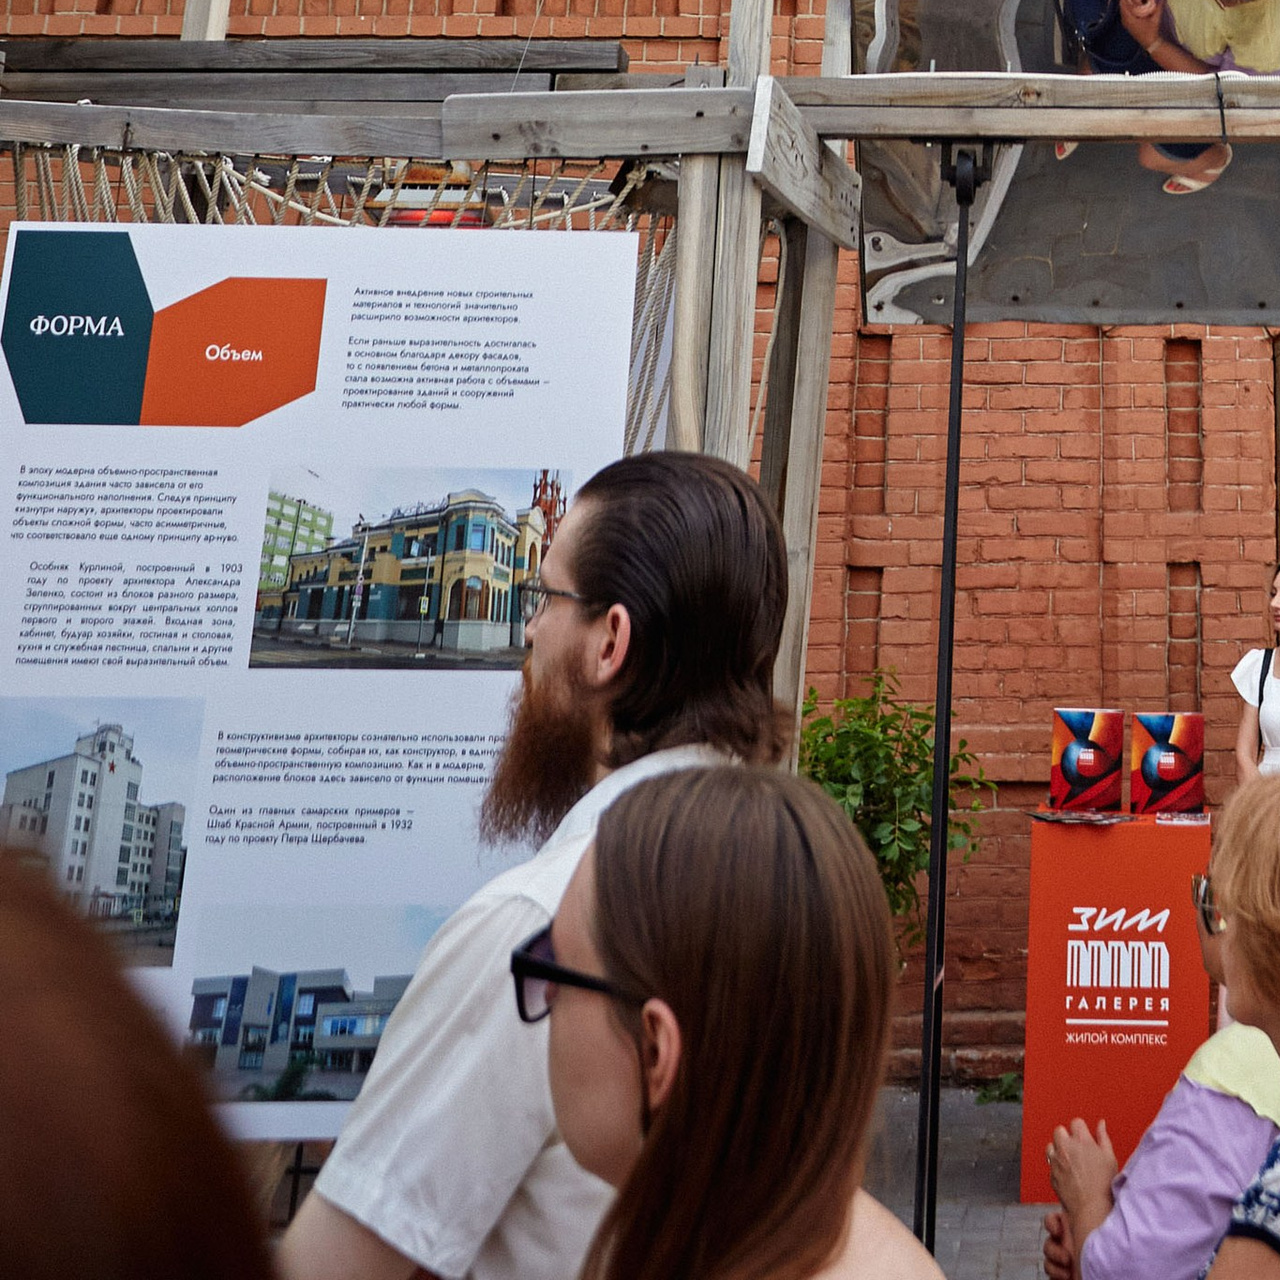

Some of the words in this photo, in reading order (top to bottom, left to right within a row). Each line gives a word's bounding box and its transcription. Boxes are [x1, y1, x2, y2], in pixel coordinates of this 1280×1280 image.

[354, 287, 394, 296] Активное
[353, 301, 402, 309] материалов
[414, 300, 461, 309] технологий
[465, 303, 518, 311] значительно
[404, 314, 460, 322] возможности
[29, 314, 125, 336] ФОРМА
[348, 336, 369, 345] Если
[409, 339, 481, 347] выразительность
[205, 344, 263, 361] Объем
[400, 350, 446, 359] благодаря
[448, 352, 480, 360] декору
[365, 363, 418, 371] появлением
[420, 362, 450, 371] бетона
[456, 375, 485, 385] работа
[496, 376, 540, 386] объемами
[343, 388, 414, 396] проектирование
[417, 388, 449, 396] зданий
[460, 389, 514, 398] сооружений
[397, 399, 427, 408] любой
[20, 465, 26, 473] В
[29, 467, 53, 475] эпоху
[55, 468, 95, 476] модерна
[16, 493, 95, 501] функционального
[157, 492, 191, 503] Следуя
[193, 495, 237, 503] принципу
[15, 506, 54, 514] «изнутри
[100, 507, 154, 515] архитекторы
[157, 508, 223, 516] проектировали
[13, 516, 49, 526] объекты
[27, 532, 96, 540] соответствовало
[121, 533, 155, 542] одному
[157, 534, 201, 542] принципу
[30, 561, 69, 570] Особняк
[136, 563, 195, 572] построенный
[222, 563, 243, 572] 1903
[27, 577, 47, 585] году
[79, 577, 113, 586] проекту
[123, 578, 175, 586] архитектора
[185, 577, 240, 586] Александра
[122, 588, 154, 598] блоков
[158, 591, 194, 599] разного
[24, 604, 102, 612] сгруппированных
[108, 604, 136, 613] вокруг
[408, 760, 423, 768] Как
[209, 805, 236, 814] Один
[301, 808, 348, 816] самарских
[355, 808, 400, 817] примеров
[207, 818, 231, 828] Штаб
[235, 819, 274, 830] Красной
[317, 821, 377, 829] построенный
[391, 819, 413, 829] 1932
[205, 835, 225, 844] году
[243, 835, 278, 844] проекту
[281, 833, 308, 844] Петра
[1068, 907, 1170, 933] ЗИМ
[1065, 996, 1169, 1012] ГАЛЕРЕЯ
[1065, 1030, 1108, 1045] ЖИЛОЙ
[1111, 1032, 1168, 1045] КОМПЛЕКС
